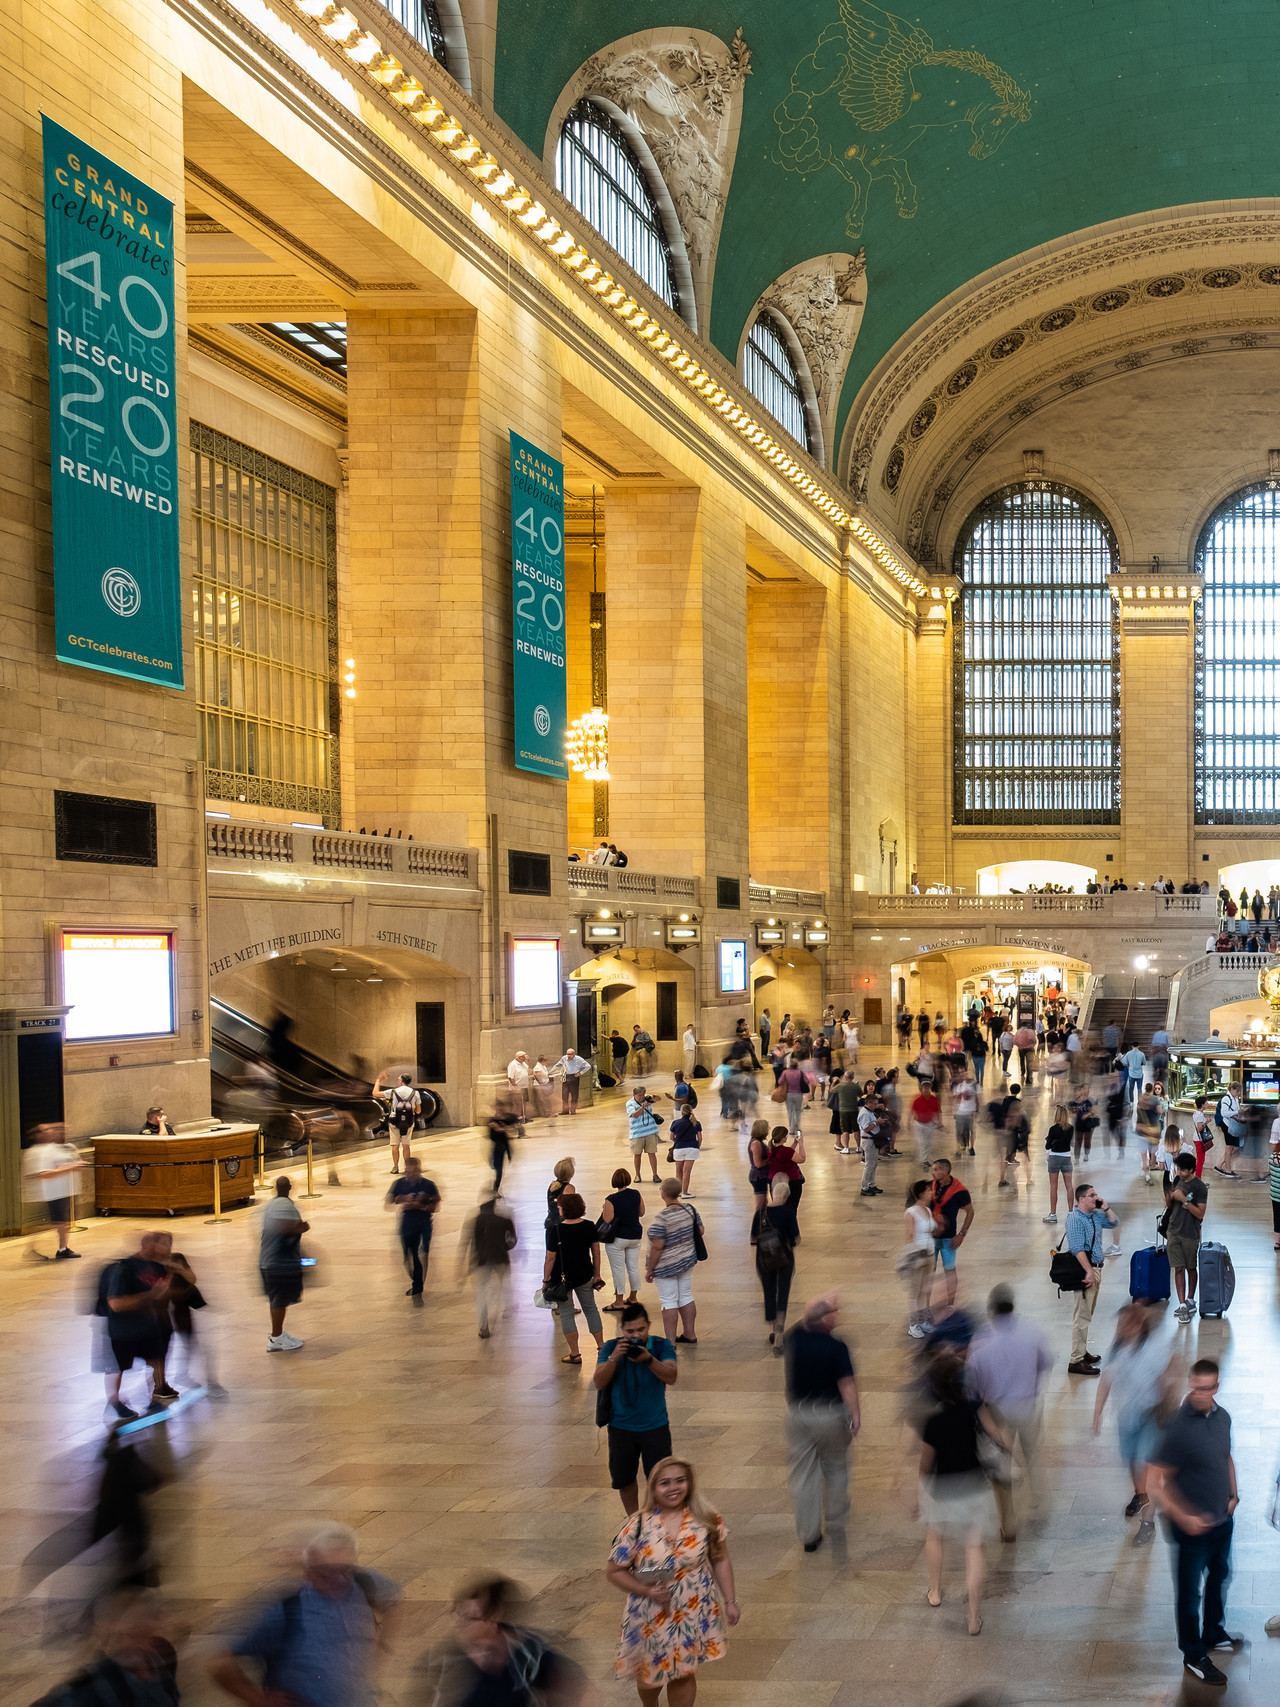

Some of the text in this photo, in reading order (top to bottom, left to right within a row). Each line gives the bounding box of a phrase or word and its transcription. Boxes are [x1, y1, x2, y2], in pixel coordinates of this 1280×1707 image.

[66, 152, 150, 217] GRAND
[55, 167, 165, 249] CENTRAL
[51, 186, 171, 277] celebrates
[56, 250, 168, 339] 40
[58, 295, 168, 374] YEARS
[57, 327, 170, 398] RESCUED
[59, 363, 171, 457] 20
[60, 421, 172, 492] YEARS
[519, 448, 554, 477] GRAND
[59, 456, 173, 515] RENEWED
[513, 472, 563, 513] celebrates
[514, 460, 561, 496] CENTRAL
[515, 507, 562, 556] 40
[515, 539, 563, 577] YEARS
[515, 559, 563, 592] RESCUED
[516, 580, 563, 631] 20
[67, 634, 173, 671] GCTcelebrates.com
[516, 639, 565, 668] RENEWED
[517, 618, 564, 652] YEARS
[520, 750, 565, 768] GCTcelebrates.com
[70, 938, 163, 949] SERVICE ADVISORY
[209, 928, 341, 977] THE METLIFE BUILDING
[376, 930, 438, 953] 45TH STREET
[921, 941, 950, 952] TRACKS
[1004, 937, 1065, 952] LEXINGTON AVE
[988, 961, 1011, 970] STREET
